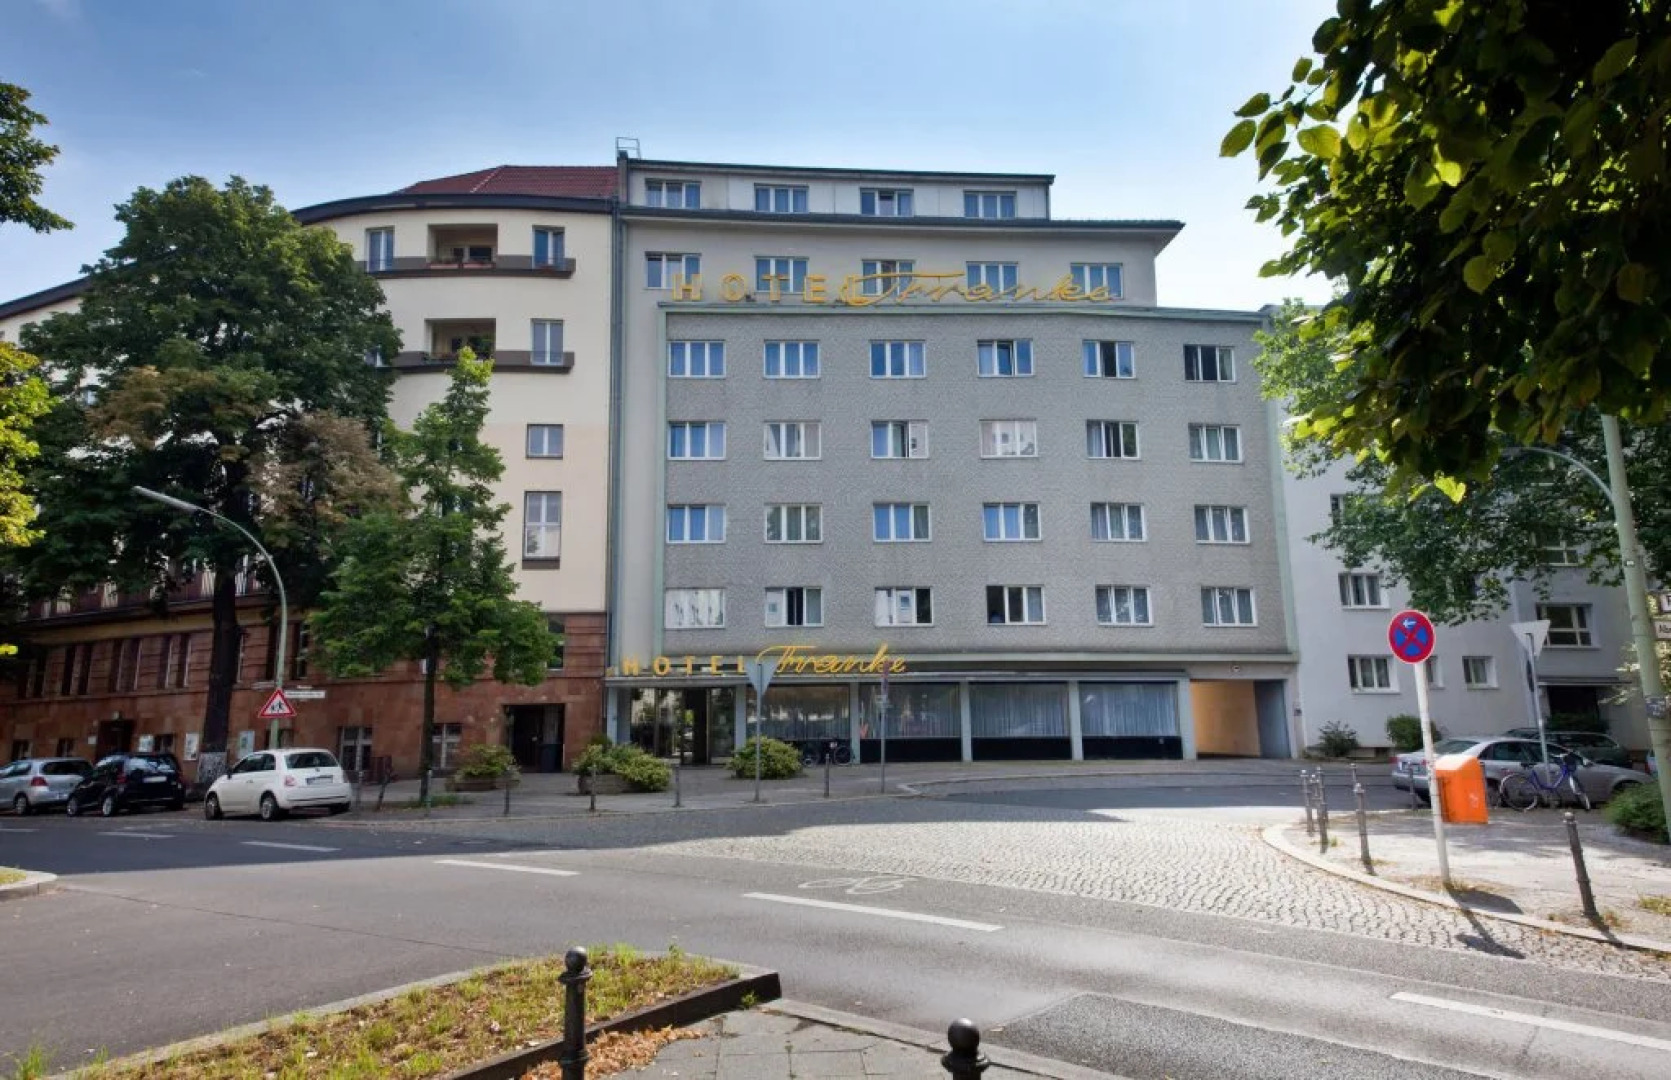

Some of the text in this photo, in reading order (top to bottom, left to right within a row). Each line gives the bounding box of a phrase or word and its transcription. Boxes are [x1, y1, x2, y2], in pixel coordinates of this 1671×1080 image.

[672, 271, 1117, 306] HOTEL Franke
[622, 642, 906, 676] HOTEL Franke
